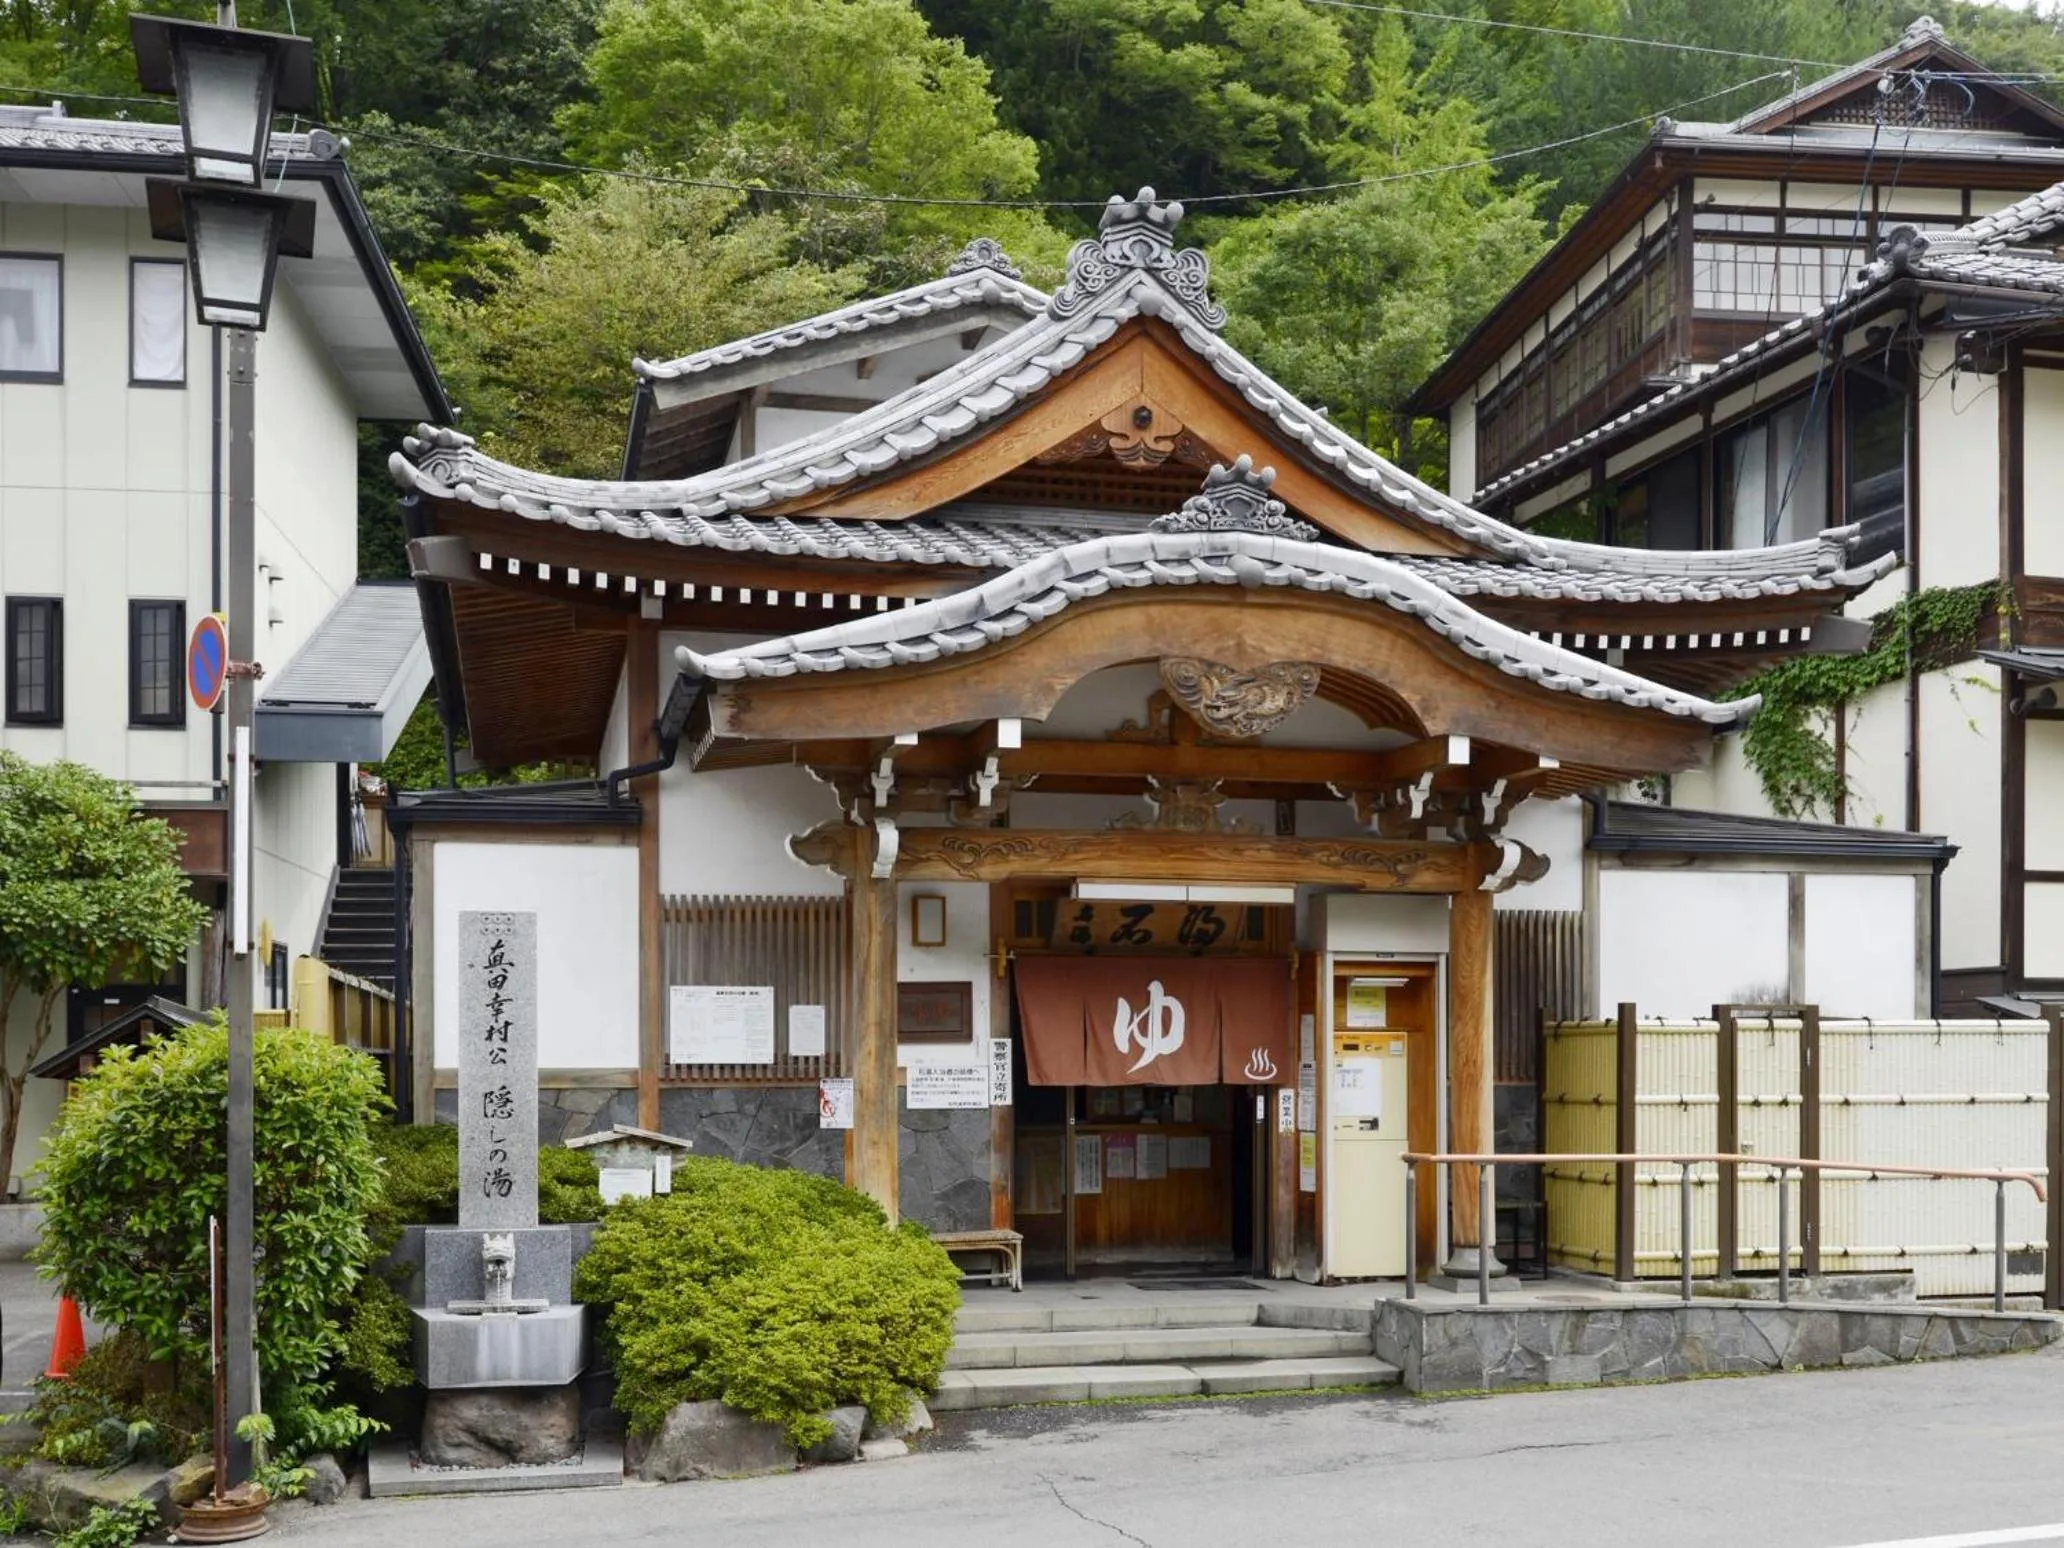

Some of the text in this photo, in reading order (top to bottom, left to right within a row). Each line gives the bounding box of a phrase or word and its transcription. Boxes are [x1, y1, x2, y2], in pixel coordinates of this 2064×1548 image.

[483, 938, 515, 1066] 真田幸村公
[1112, 979, 1186, 1075] ゆ
[993, 1041, 1008, 1102] 警察官立寄所
[483, 1085, 515, 1199] 隠しの湯
